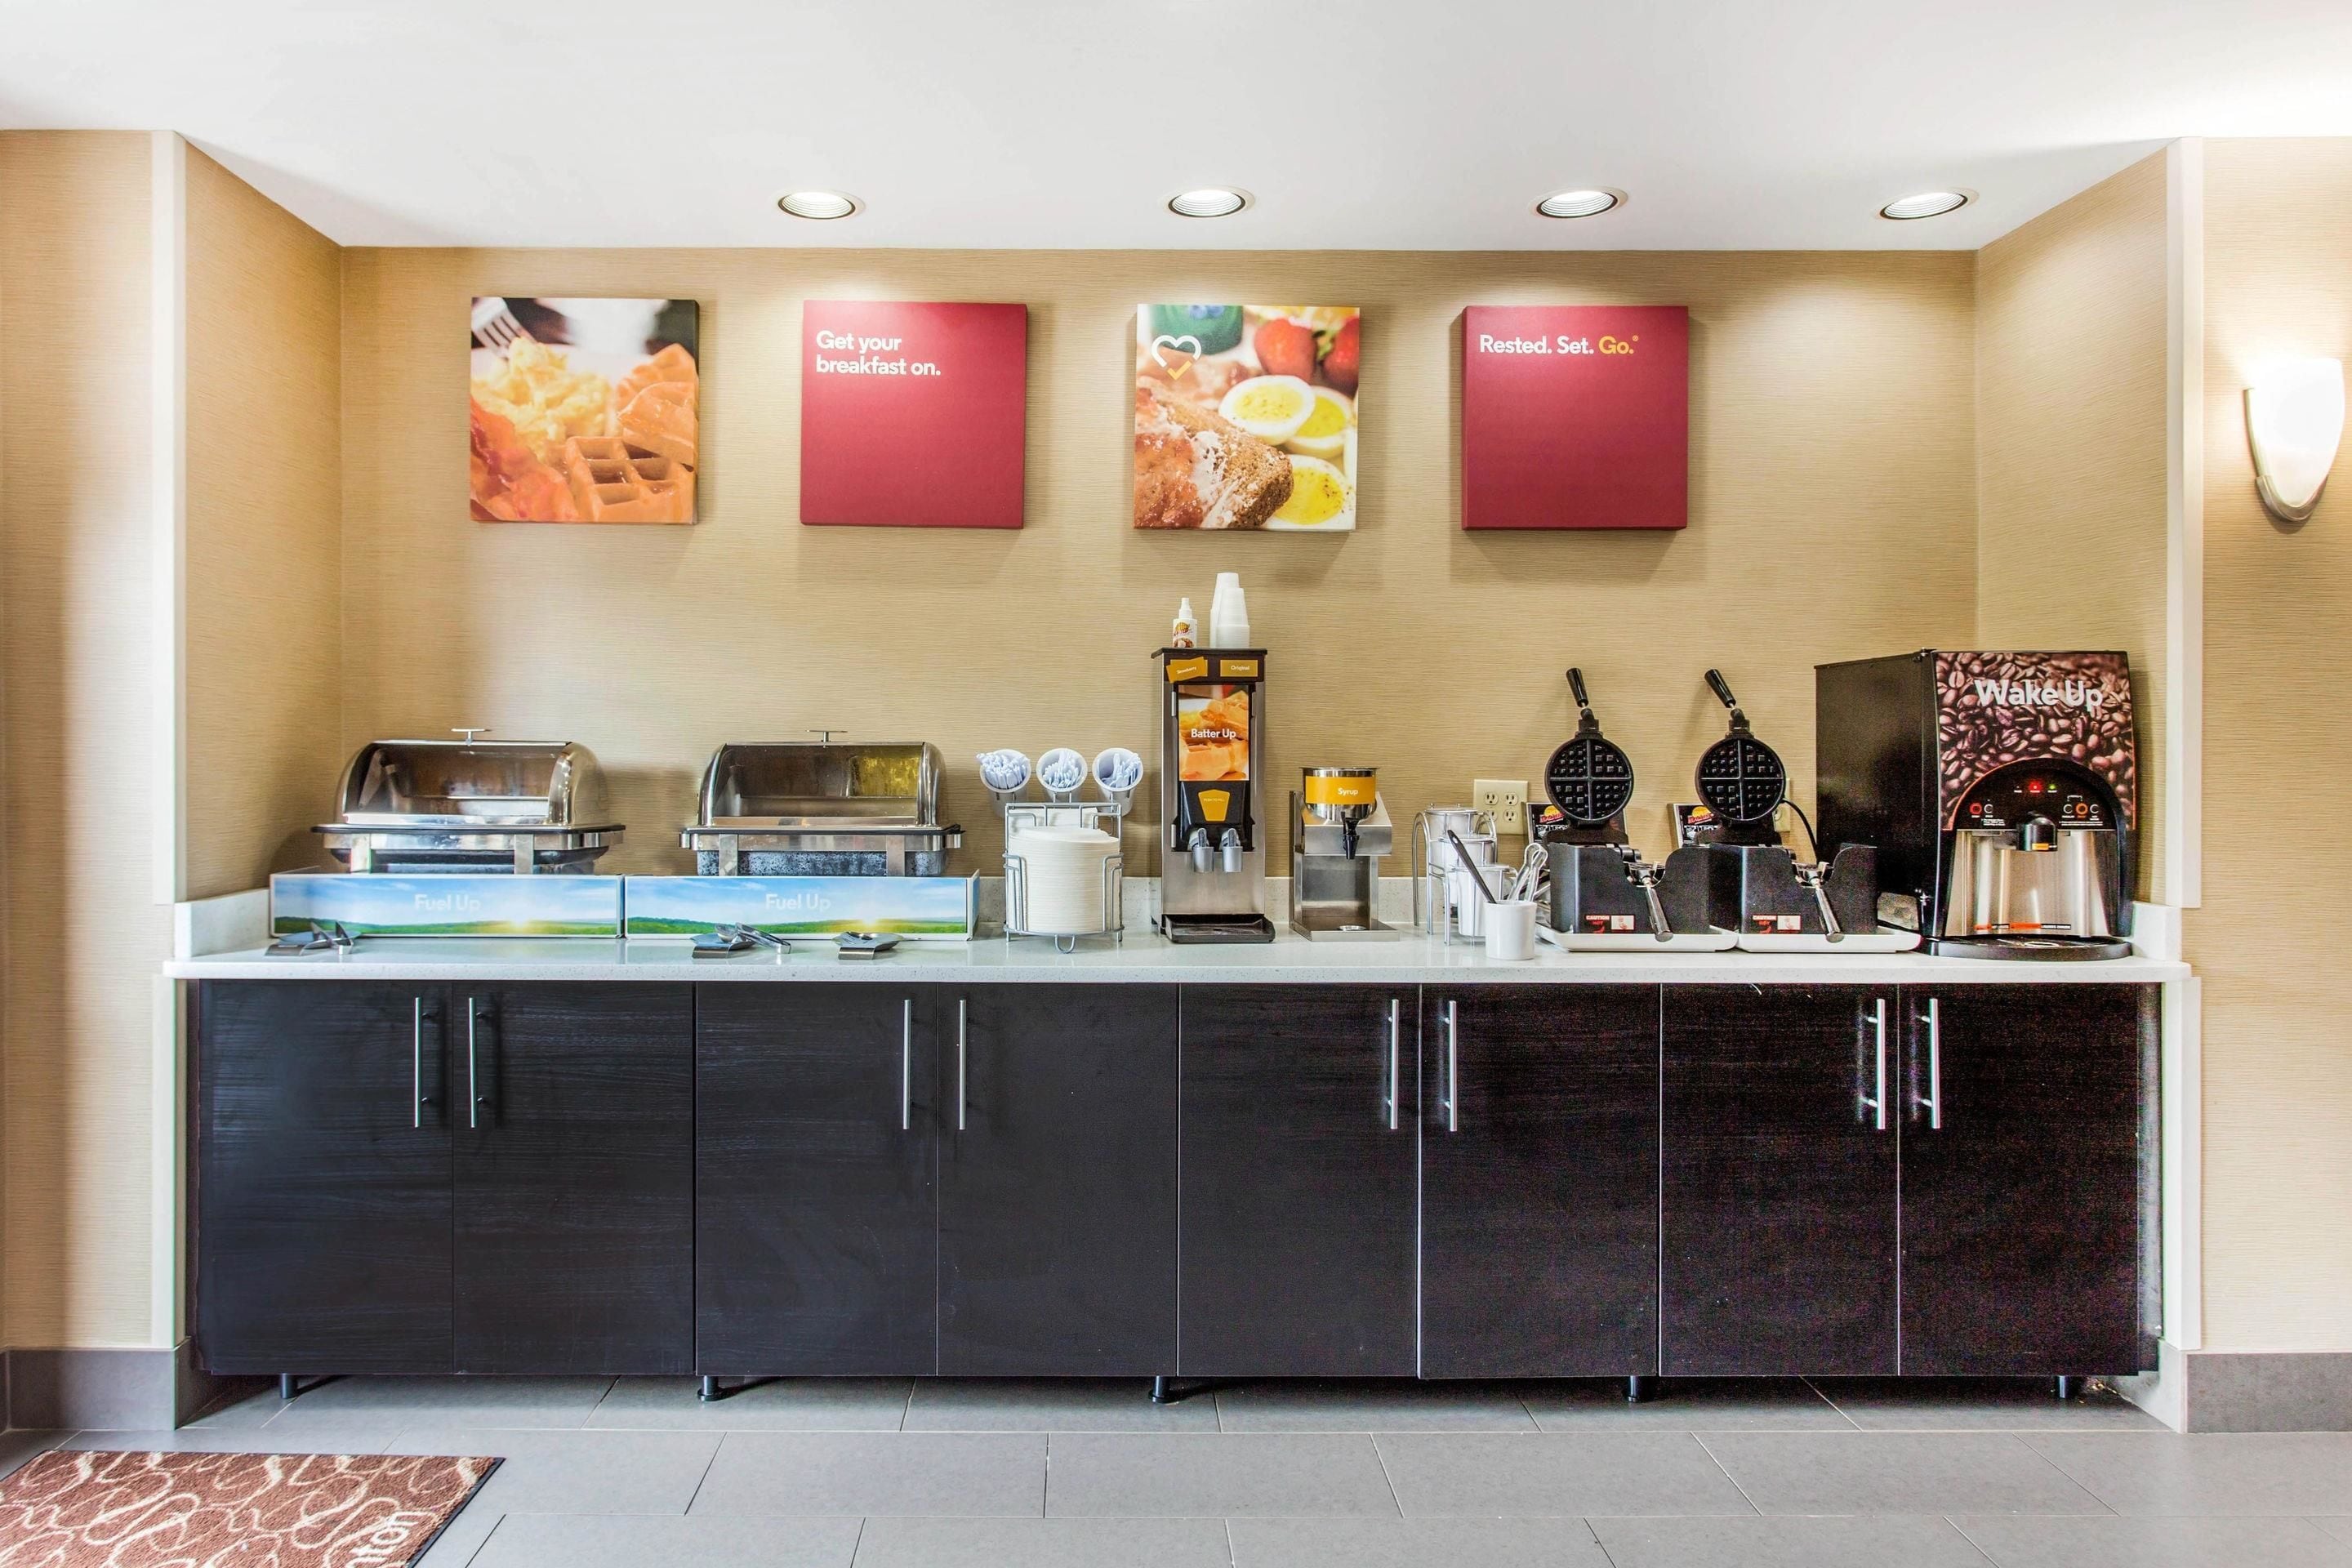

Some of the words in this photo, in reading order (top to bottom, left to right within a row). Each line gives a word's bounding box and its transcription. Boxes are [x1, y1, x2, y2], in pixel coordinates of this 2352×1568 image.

[816, 330, 854, 350] Get
[858, 336, 902, 354] your
[1479, 334, 1552, 354] Rested.
[1557, 335, 1594, 355] Set.
[816, 354, 906, 375] breakfast
[910, 363, 942, 376] on.
[1974, 679, 2059, 707] Wake
[2065, 679, 2104, 712] Up
[1191, 728, 1220, 738] Batter
[1222, 728, 1236, 740] Up
[1337, 787, 1359, 796] Syrup
[414, 893, 452, 911] Fuel
[455, 893, 482, 914] Up
[765, 893, 802, 911] Fuel
[805, 893, 831, 914] Up
